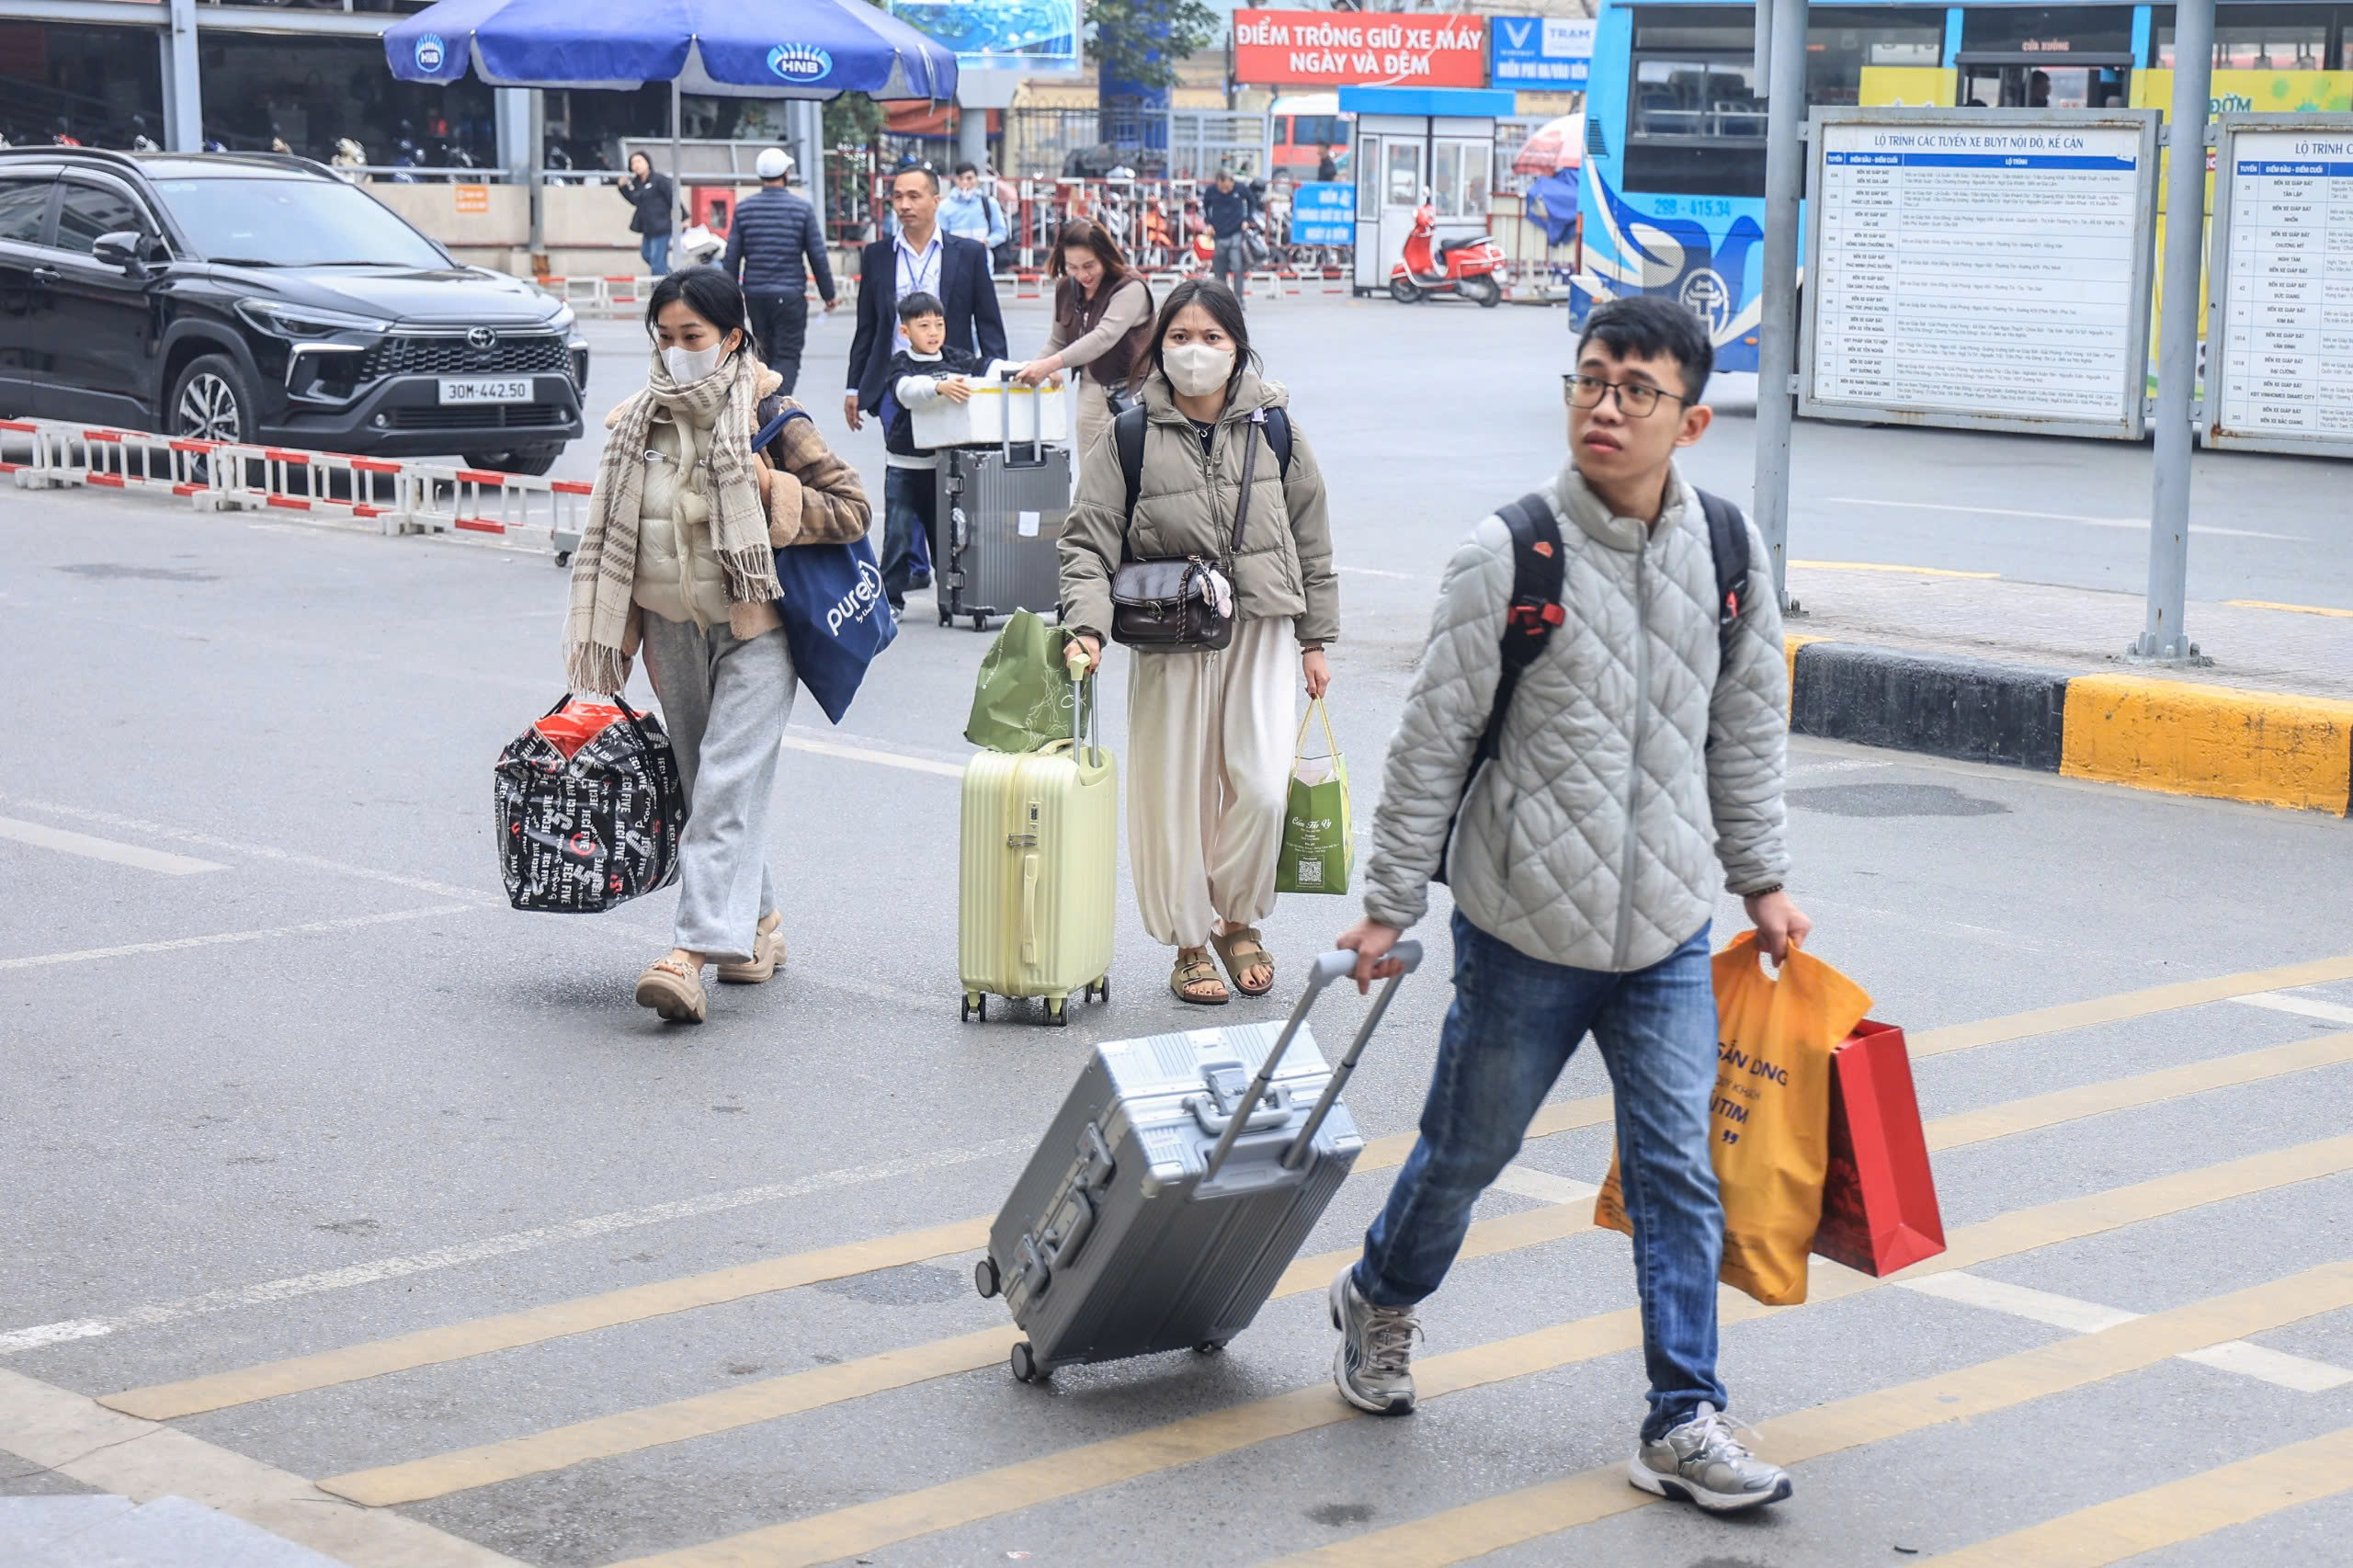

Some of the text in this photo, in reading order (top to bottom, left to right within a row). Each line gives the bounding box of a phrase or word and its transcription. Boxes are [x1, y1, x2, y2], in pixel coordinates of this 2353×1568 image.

[1237, 16, 1483, 51] ĐIỂM TRÔNG GIỮ XE MÁY
[781, 60, 818, 74] HNB
[1289, 49, 1431, 75] NGÀY VÀ ĐÊM
[1874, 133, 1886, 149] LỘ
[1889, 133, 1915, 147] TRÌNH
[1917, 134, 1935, 147] CÁC
[1938, 134, 1966, 147] TUYẾN
[1970, 138, 1981, 148] XE
[1984, 135, 2006, 148] BUÝT
[2010, 135, 2027, 151] NỘI
[2048, 136, 2061, 149] KẾ
[2063, 136, 2084, 152] CẬN
[2295, 142, 2309, 157] LỘ
[2313, 142, 2343, 155] TRÌNH
[635, 771, 648, 790] FIVE
[565, 778, 577, 817] JECI FIVE
[588, 791, 599, 807] JECI
[620, 793, 632, 813] FIVE
[579, 809, 592, 849] JECI FIVE
[614, 820, 625, 840] JECI
[531, 842, 540, 873] JECI FIVE
[541, 852, 552, 869] JECI
[614, 841, 626, 861] FIVE
[510, 854, 519, 874] FIVE
[562, 861, 574, 904] JECI FIVE
[520, 888, 531, 905] JECI
